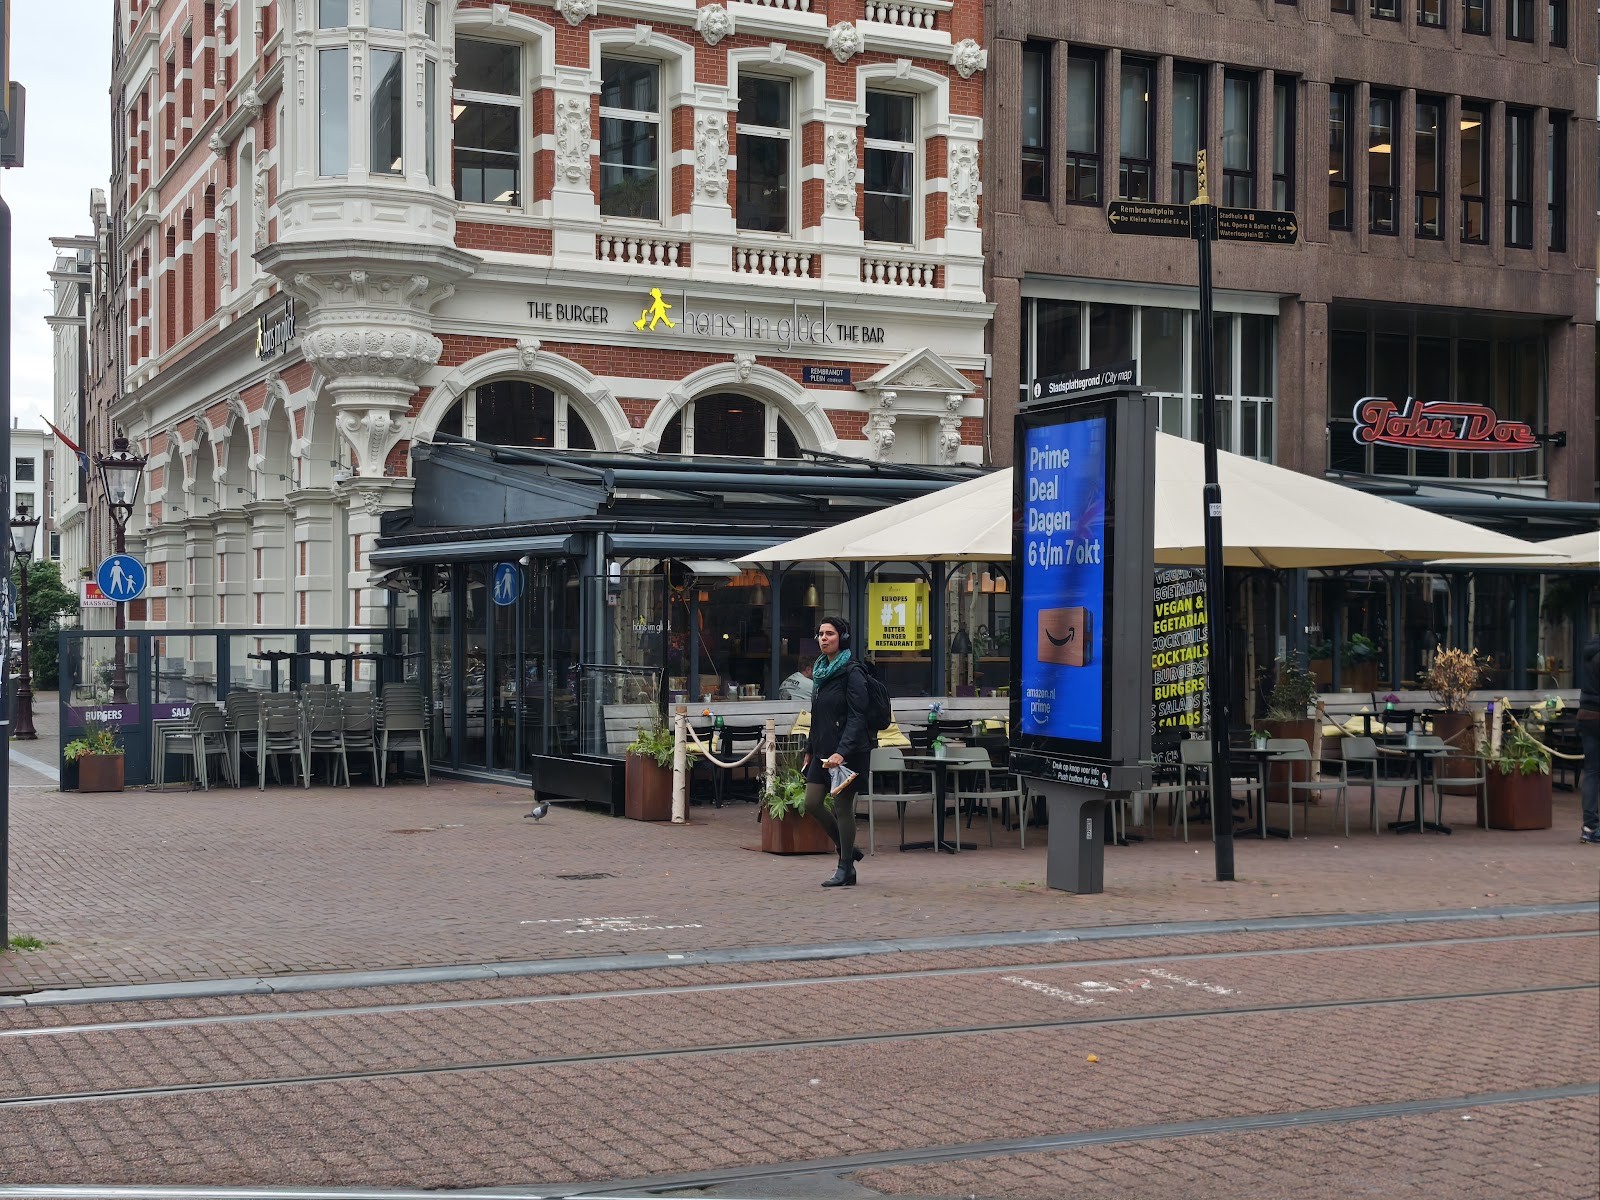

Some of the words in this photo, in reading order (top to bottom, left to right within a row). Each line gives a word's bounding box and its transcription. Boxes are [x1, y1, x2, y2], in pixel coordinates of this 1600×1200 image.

[1120, 205, 1174, 216] Rembrandtplein
[1219, 212, 1243, 220] Stadhuis
[1219, 230, 1257, 238] Waterlooplein
[527, 301, 553, 320] THE
[556, 303, 609, 324] BURGER
[682, 289, 736, 337] hans
[744, 309, 770, 340] im
[777, 298, 834, 353] glück
[837, 324, 859, 343] THE
[862, 325, 885, 343] BAR
[810, 367, 843, 376] REMBRANDT
[810, 374, 826, 382] PLEIN
[1048, 374, 1100, 393] Stadsplattegrond
[1105, 371, 1117, 384] City
[1117, 370, 1132, 382] map
[1360, 398, 1456, 442] John
[1466, 402, 1537, 443] Doe
[1029, 444, 1070, 471] Prime
[1029, 474, 1059, 502] Deal
[1028, 508, 1071, 536] Dagen
[1028, 541, 1037, 566] 6
[1039, 538, 1063, 570] t/m
[1065, 539, 1074, 565] 7
[1075, 539, 1100, 564] okt
[1154, 578, 1206, 601] EGETARIA
[881, 603, 906, 626] #1
[1155, 597, 1193, 617] VEGAN
[1195, 595, 1204, 609] &
[1154, 611, 1208, 635] EGETARIA
[1152, 626, 1208, 651] COCKTAILS
[1152, 643, 1209, 669] COCKTAILS
[1154, 660, 1205, 685] BURGERS
[1026, 688, 1056, 700] amazon.nl
[1155, 677, 1205, 700] BURGERS
[85, 709, 122, 721] BURGERS
[171, 707, 192, 718] SALA
[1031, 699, 1051, 715] prime
[1158, 694, 1200, 717] SALADS
[1052, 760, 1062, 770] Druk
[1063, 764, 1069, 772] op
[1069, 763, 1080, 774] knop
[1091, 767, 1099, 776] info
[1058, 771, 1068, 781] Push
[1069, 774, 1083, 783] button
[1090, 777, 1099, 786] info
